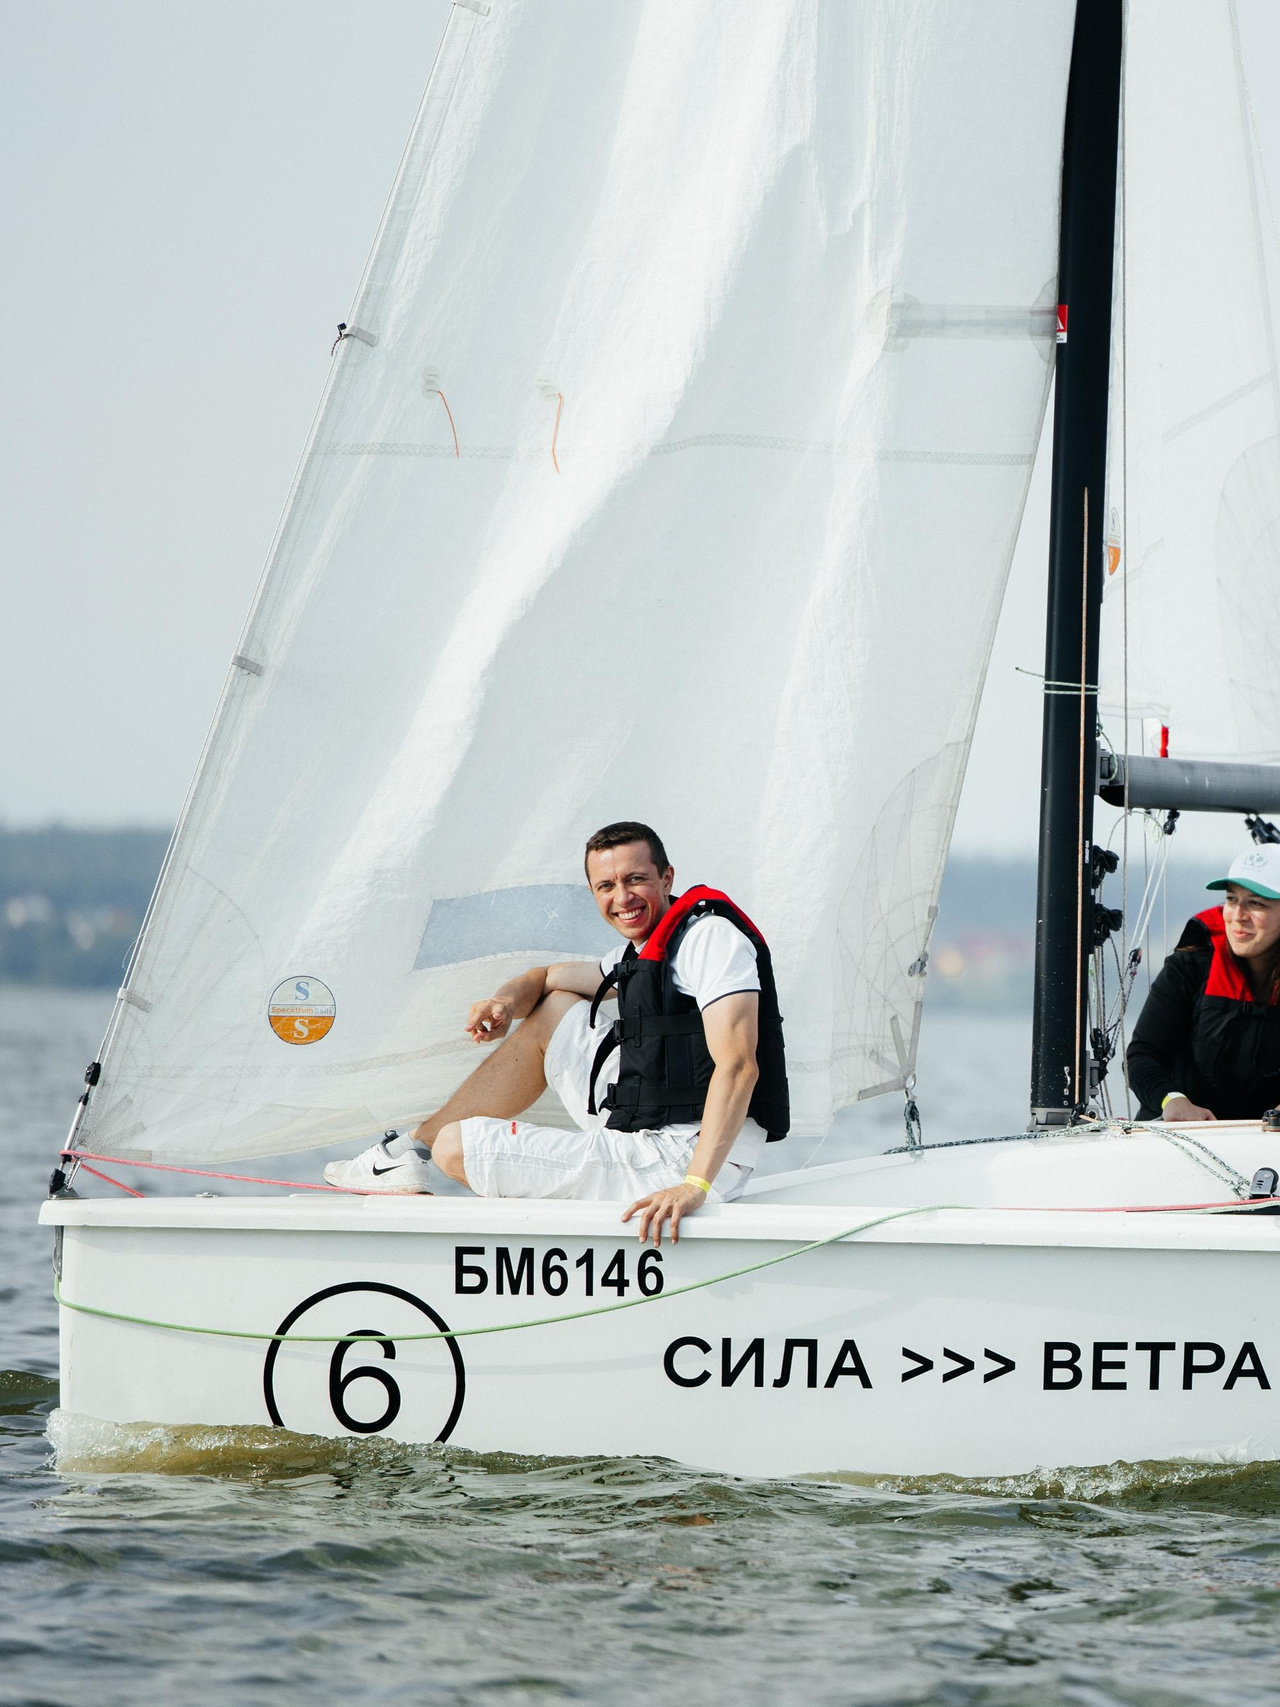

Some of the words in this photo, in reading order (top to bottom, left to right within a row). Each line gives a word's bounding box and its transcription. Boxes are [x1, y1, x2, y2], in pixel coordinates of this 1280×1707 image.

[294, 981, 310, 1001] S
[271, 1006, 314, 1014] Specktrum
[293, 1018, 309, 1039] S
[454, 1246, 664, 1297] БМ6146
[329, 1329, 401, 1434] 6
[663, 1336, 873, 1389] СИЛА
[1042, 1341, 1272, 1391] ВЕТРА
